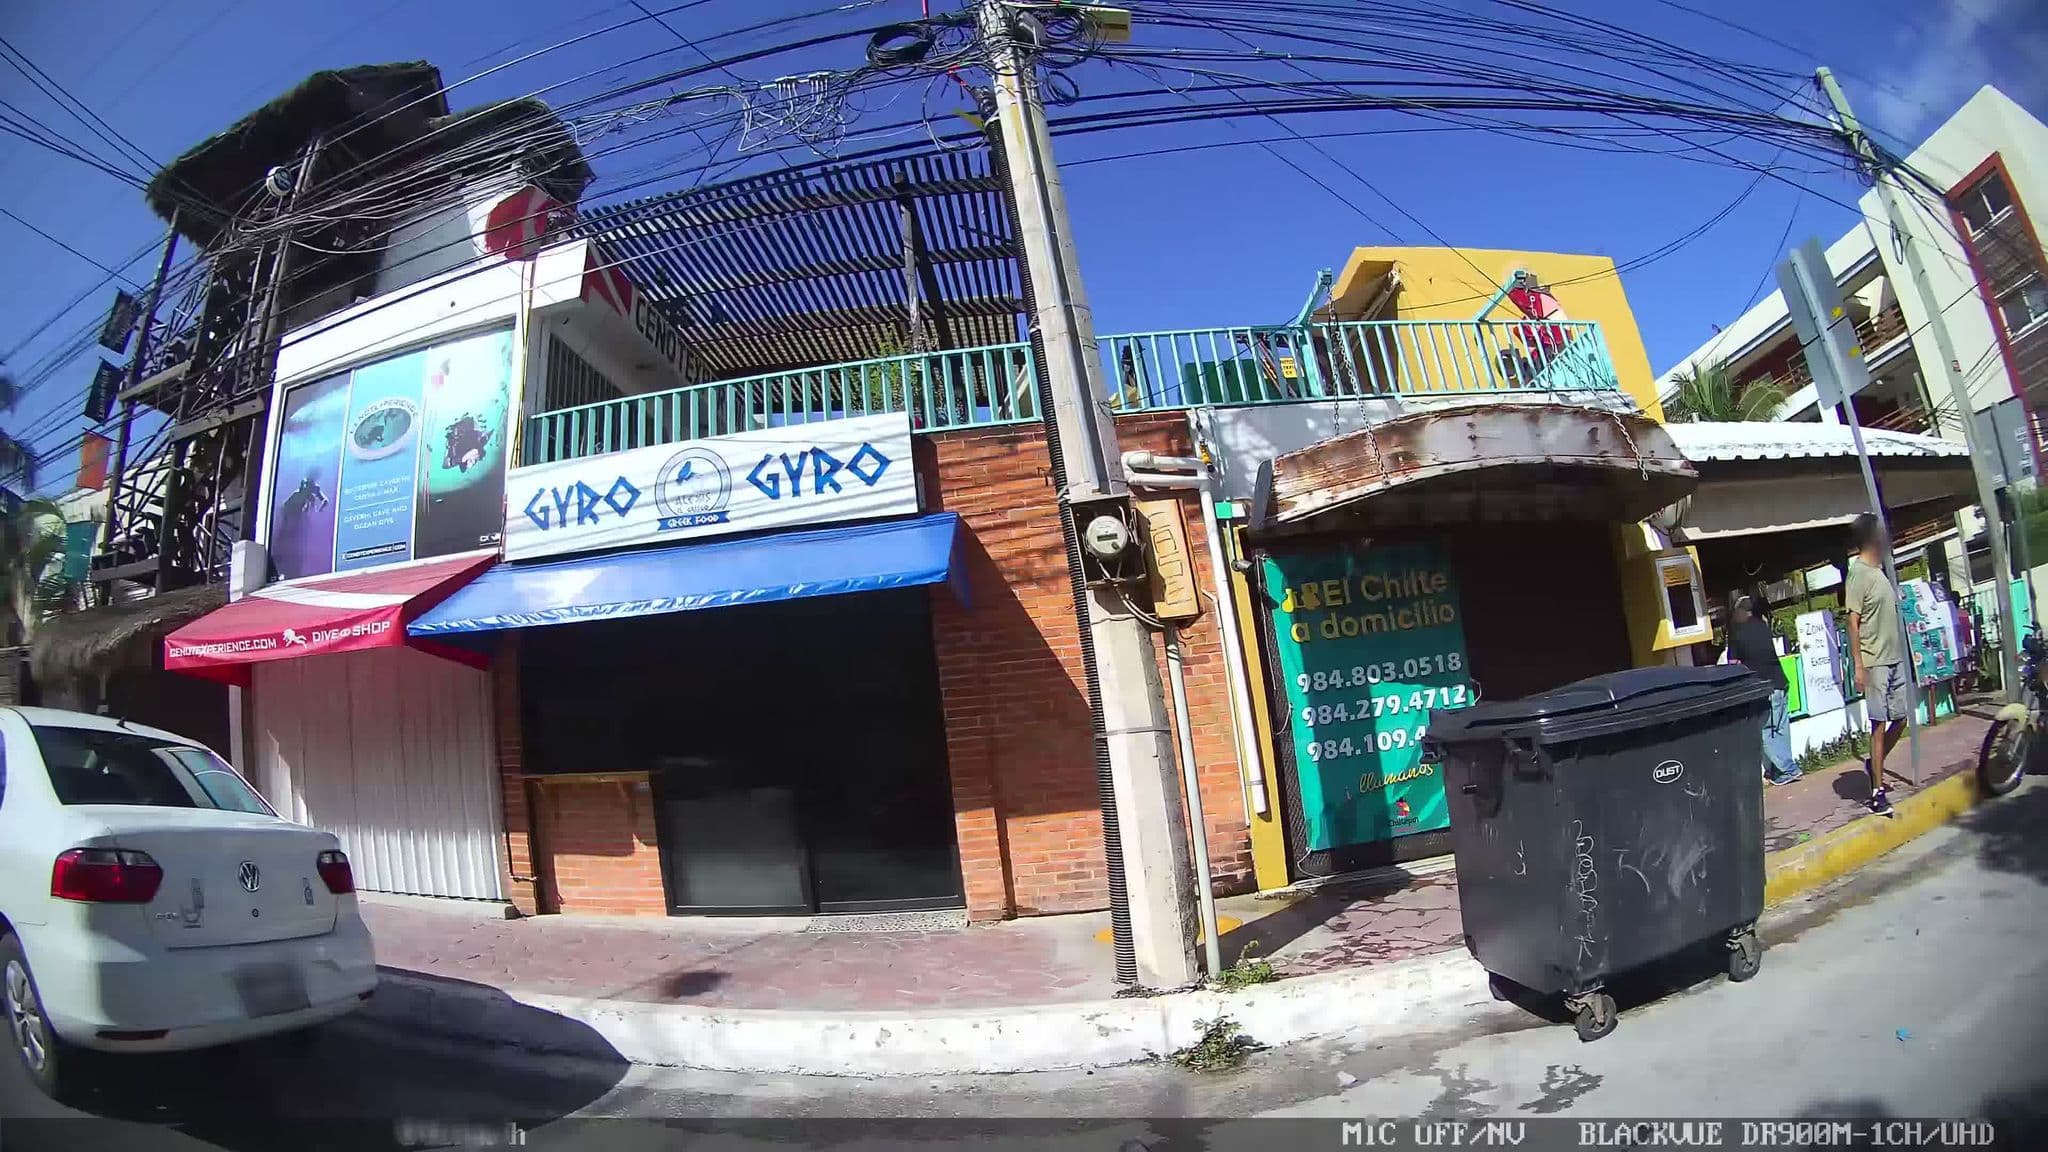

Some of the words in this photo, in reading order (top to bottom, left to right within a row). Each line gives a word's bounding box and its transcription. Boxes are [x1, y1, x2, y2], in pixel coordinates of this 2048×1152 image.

[745, 442, 893, 500] GYRO
[523, 475, 643, 532] GYRO
[667, 515, 693, 529] GREEK
[695, 512, 720, 525] FOOD
[1321, 577, 1352, 607] El
[312, 628, 339, 643] DIVE
[352, 620, 391, 637] SHOP
[1290, 620, 1311, 643] a
[1319, 598, 1456, 640] domicilio
[1297, 652, 1462, 694] 984.803.0518
[1302, 684, 1467, 727] 984.279.4712
[1307, 725, 1427, 763] 984.109.4
